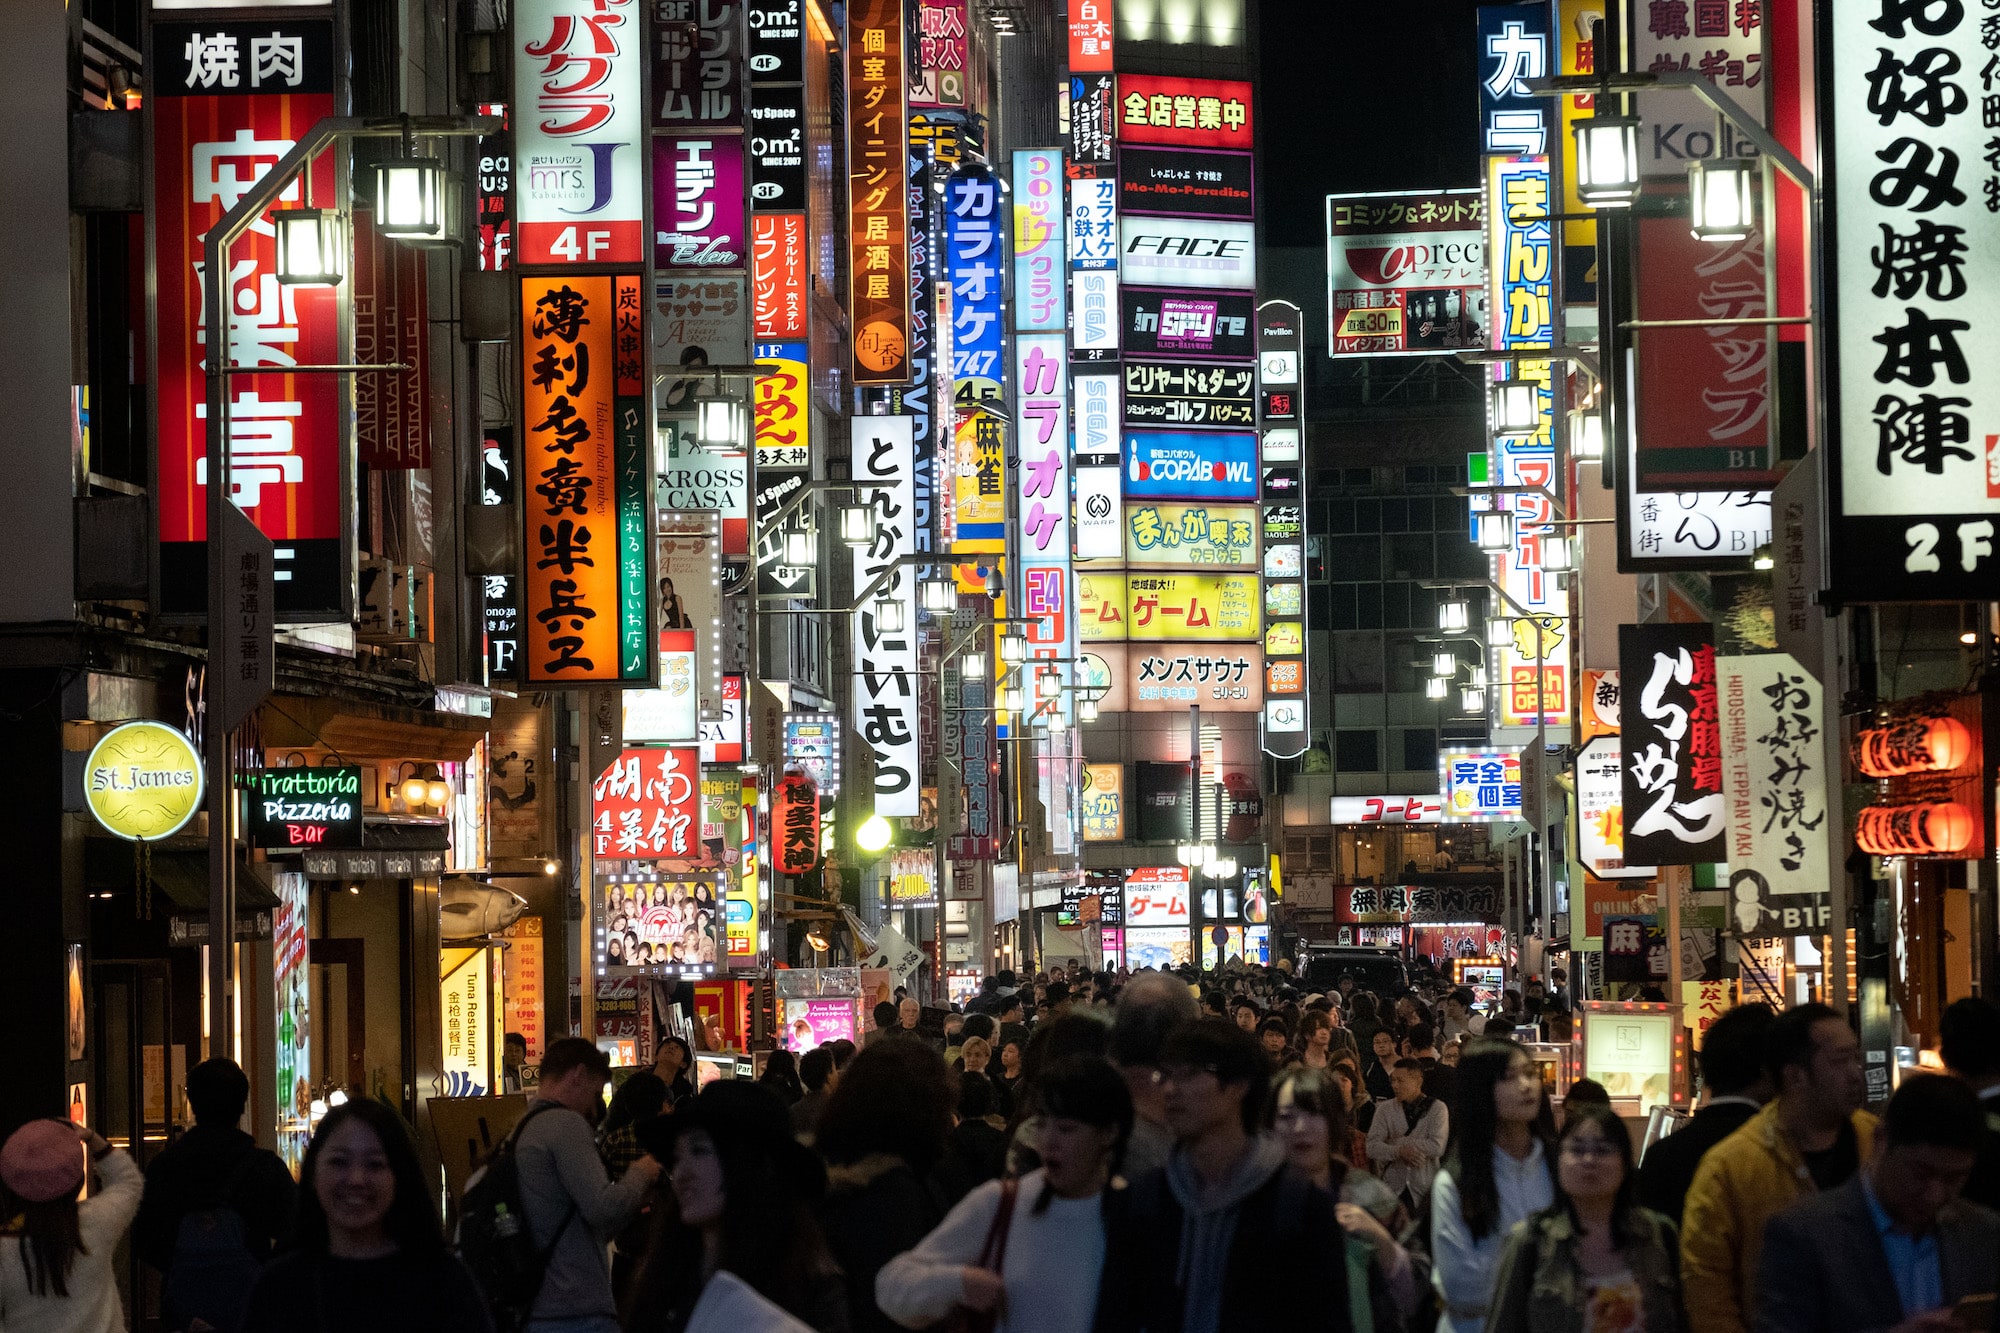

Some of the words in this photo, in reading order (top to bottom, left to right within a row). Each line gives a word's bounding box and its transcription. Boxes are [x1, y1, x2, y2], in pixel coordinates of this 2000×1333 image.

[759, 30, 779, 38] SINCE
[780, 29, 799, 38] 2007
[185, 32, 303, 88] 焼肉
[700, 2, 732, 121] レンタル
[755, 57, 774, 69] 4F
[764, 107, 796, 119] Space
[1123, 91, 1247, 132] 全店営業中
[1090, 89, 1102, 161] インターネット
[762, 157, 780, 166] SINCE
[781, 157, 802, 166] 2007
[861, 28, 891, 300] 個室ダイニング居酒屋
[1150, 167, 1191, 181] しゃぶしゃぶ
[558, 143, 631, 214] J
[675, 140, 716, 233] エデン
[757, 185, 776, 197] 3F
[1123, 181, 1250, 198] Mo-Mo-Paradise
[531, 191, 586, 199] Kabukicho
[1074, 205, 1095, 257] の鉄人
[1096, 180, 1115, 257] カラオケ
[549, 226, 612, 260] 4F
[670, 235, 739, 265] Eden
[1126, 234, 1249, 259] FACE
[952, 177, 999, 345] カラオケ
[754, 218, 778, 337] リフレッシュ
[786, 291, 799, 331] ホステル
[1084, 275, 1107, 344] SEGA
[1336, 290, 1402, 308] 新宿最大
[757, 345, 782, 357] 1F
[953, 351, 997, 375] 747
[1088, 350, 1104, 360] 2F
[1125, 365, 1253, 397] ビリヤード&ダーツ
[1086, 380, 1109, 449] SEGA
[1165, 400, 1207, 423] ゴルフ
[975, 415, 1002, 496] 麻雀
[1022, 346, 1063, 550] カラオケ
[1090, 454, 1106, 465] 1F
[1729, 451, 1758, 468] B1
[658, 469, 744, 489] XROSS
[765, 476, 802, 500] Space
[667, 490, 737, 509] CASA
[1131, 506, 1252, 550] まんが喫茶
[1905, 520, 1995, 574] 2F
[778, 568, 797, 578] B1
[1079, 601, 1122, 623] ーム
[1132, 593, 1211, 628] ゲーム
[1138, 657, 1250, 683] メンズサウナ
[1515, 693, 1562, 711] OPEN
[1455, 761, 1504, 785] 完全
[1757, 672, 1825, 871] お好み焼き
[1477, 784, 1522, 807] 個室
[1360, 797, 1441, 822] コーヒー
[286, 823, 328, 844] Bar
[1130, 895, 1187, 915] ゲーム
[1350, 885, 1497, 914] 無料案内所
[1782, 906, 1832, 929] B1F
[466, 972, 477, 1000] Tuna
[466, 1001, 477, 1068] Restaurant
